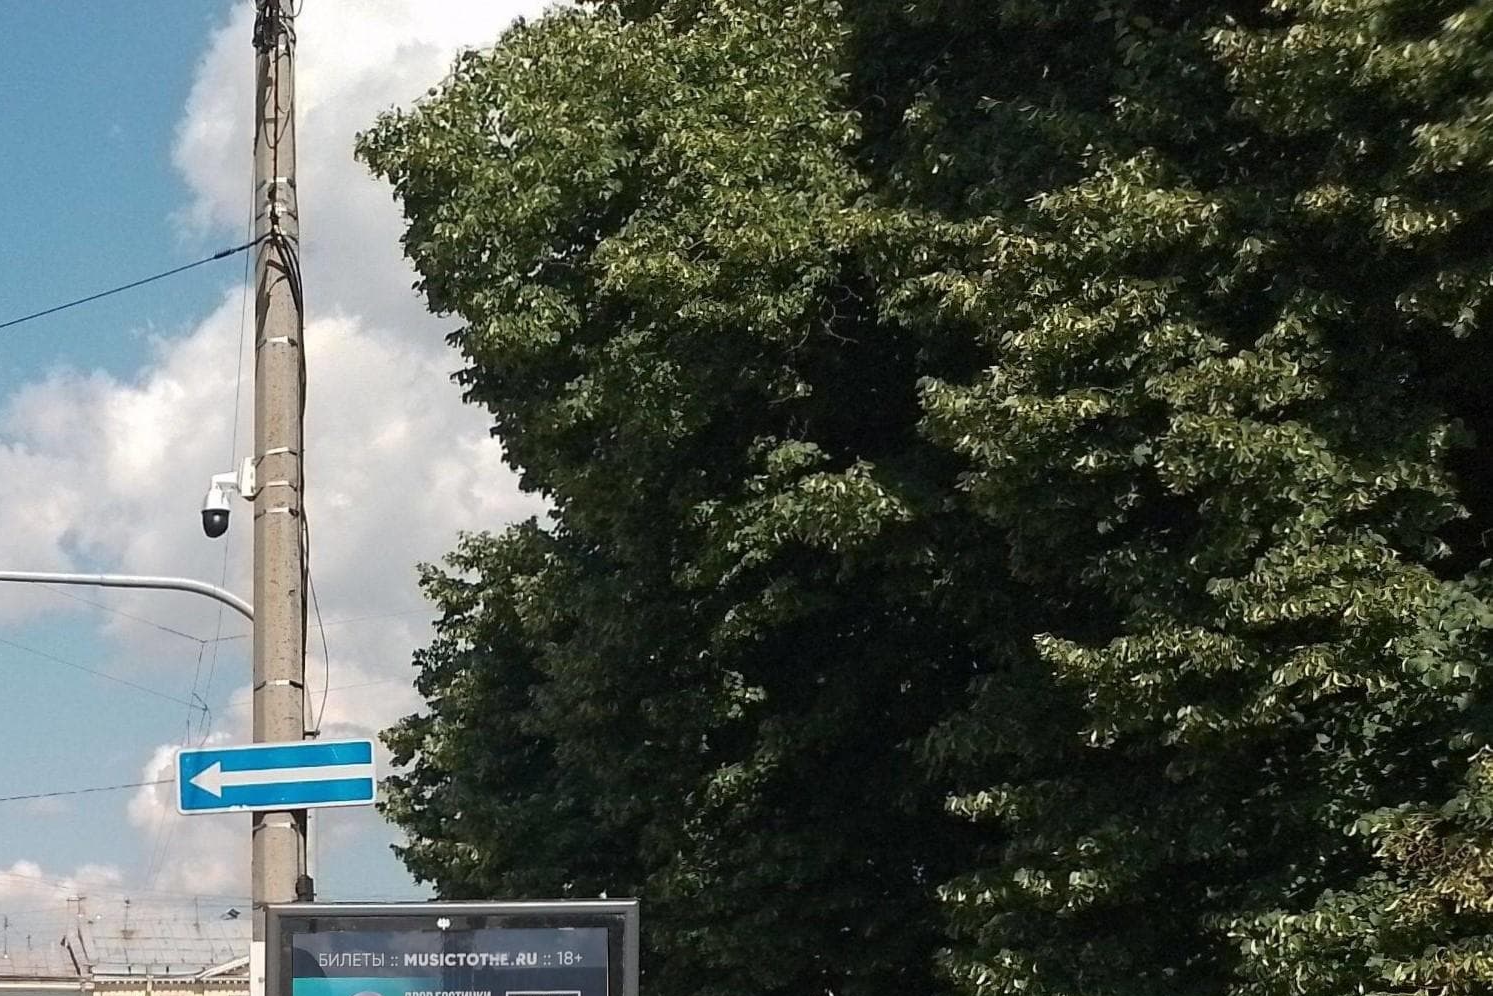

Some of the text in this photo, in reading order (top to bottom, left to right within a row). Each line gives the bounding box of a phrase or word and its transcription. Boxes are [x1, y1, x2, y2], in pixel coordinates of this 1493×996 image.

[318, 952, 385, 968] БИЛЕТЫ
[404, 952, 538, 967] MUSICTOTHE.RU
[556, 951, 583, 966] 18+
